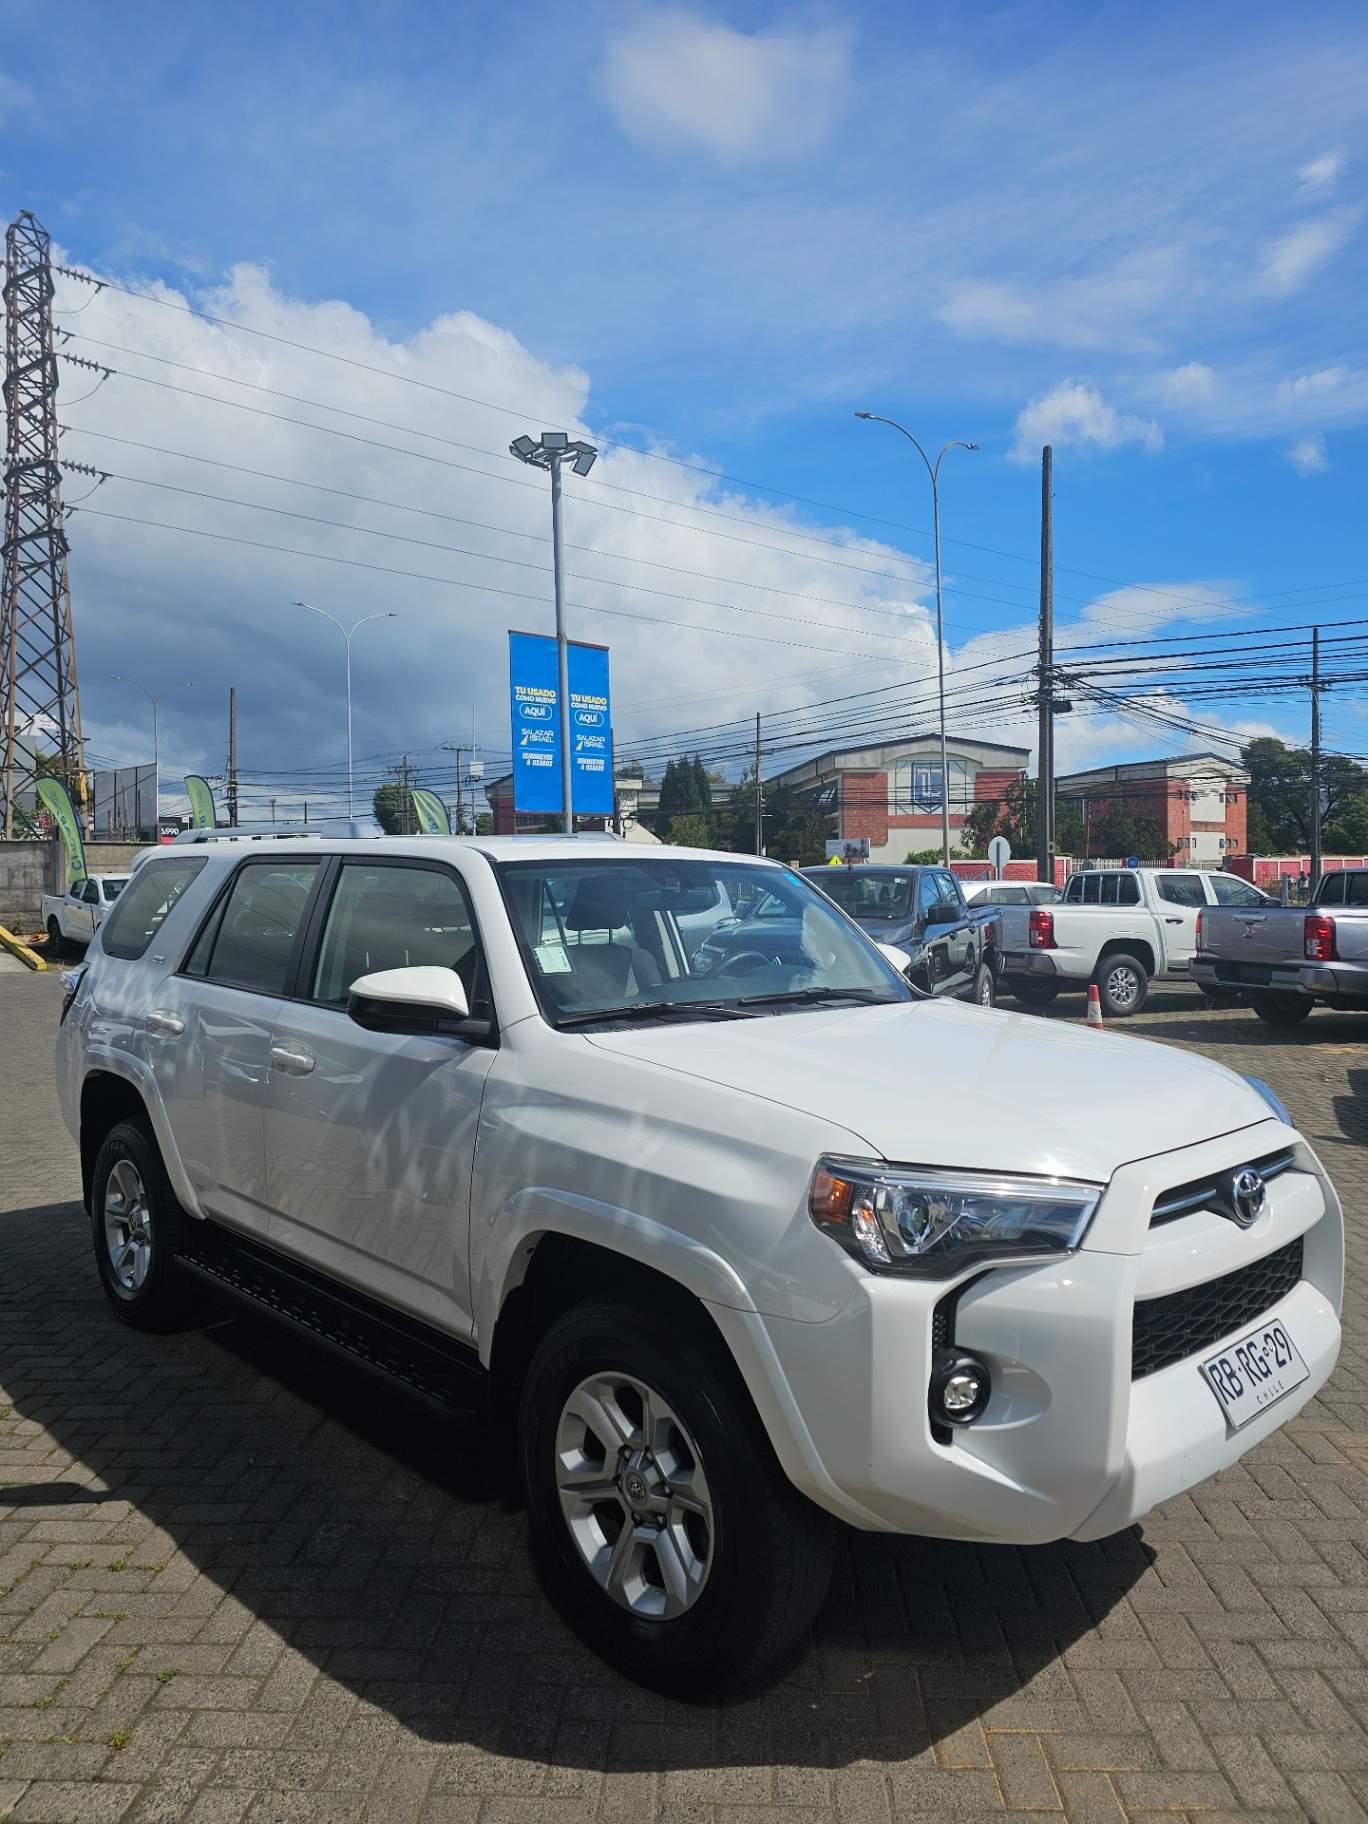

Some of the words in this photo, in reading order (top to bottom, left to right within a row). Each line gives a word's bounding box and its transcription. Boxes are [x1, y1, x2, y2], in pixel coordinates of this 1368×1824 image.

[515, 686, 526, 695] TU
[527, 688, 556, 697] USADO
[582, 695, 607, 704] USADO
[524, 706, 546, 716] AQUÍ
[579, 714, 597, 723] AQUÍ
[521, 728, 554, 736] SALAZAR
[529, 735, 555, 743] ISRAEL
[576, 734, 605, 742] SALAZAR
[583, 740, 606, 748] ISRAEL
[1256, 1380, 1284, 1404] CHILE
